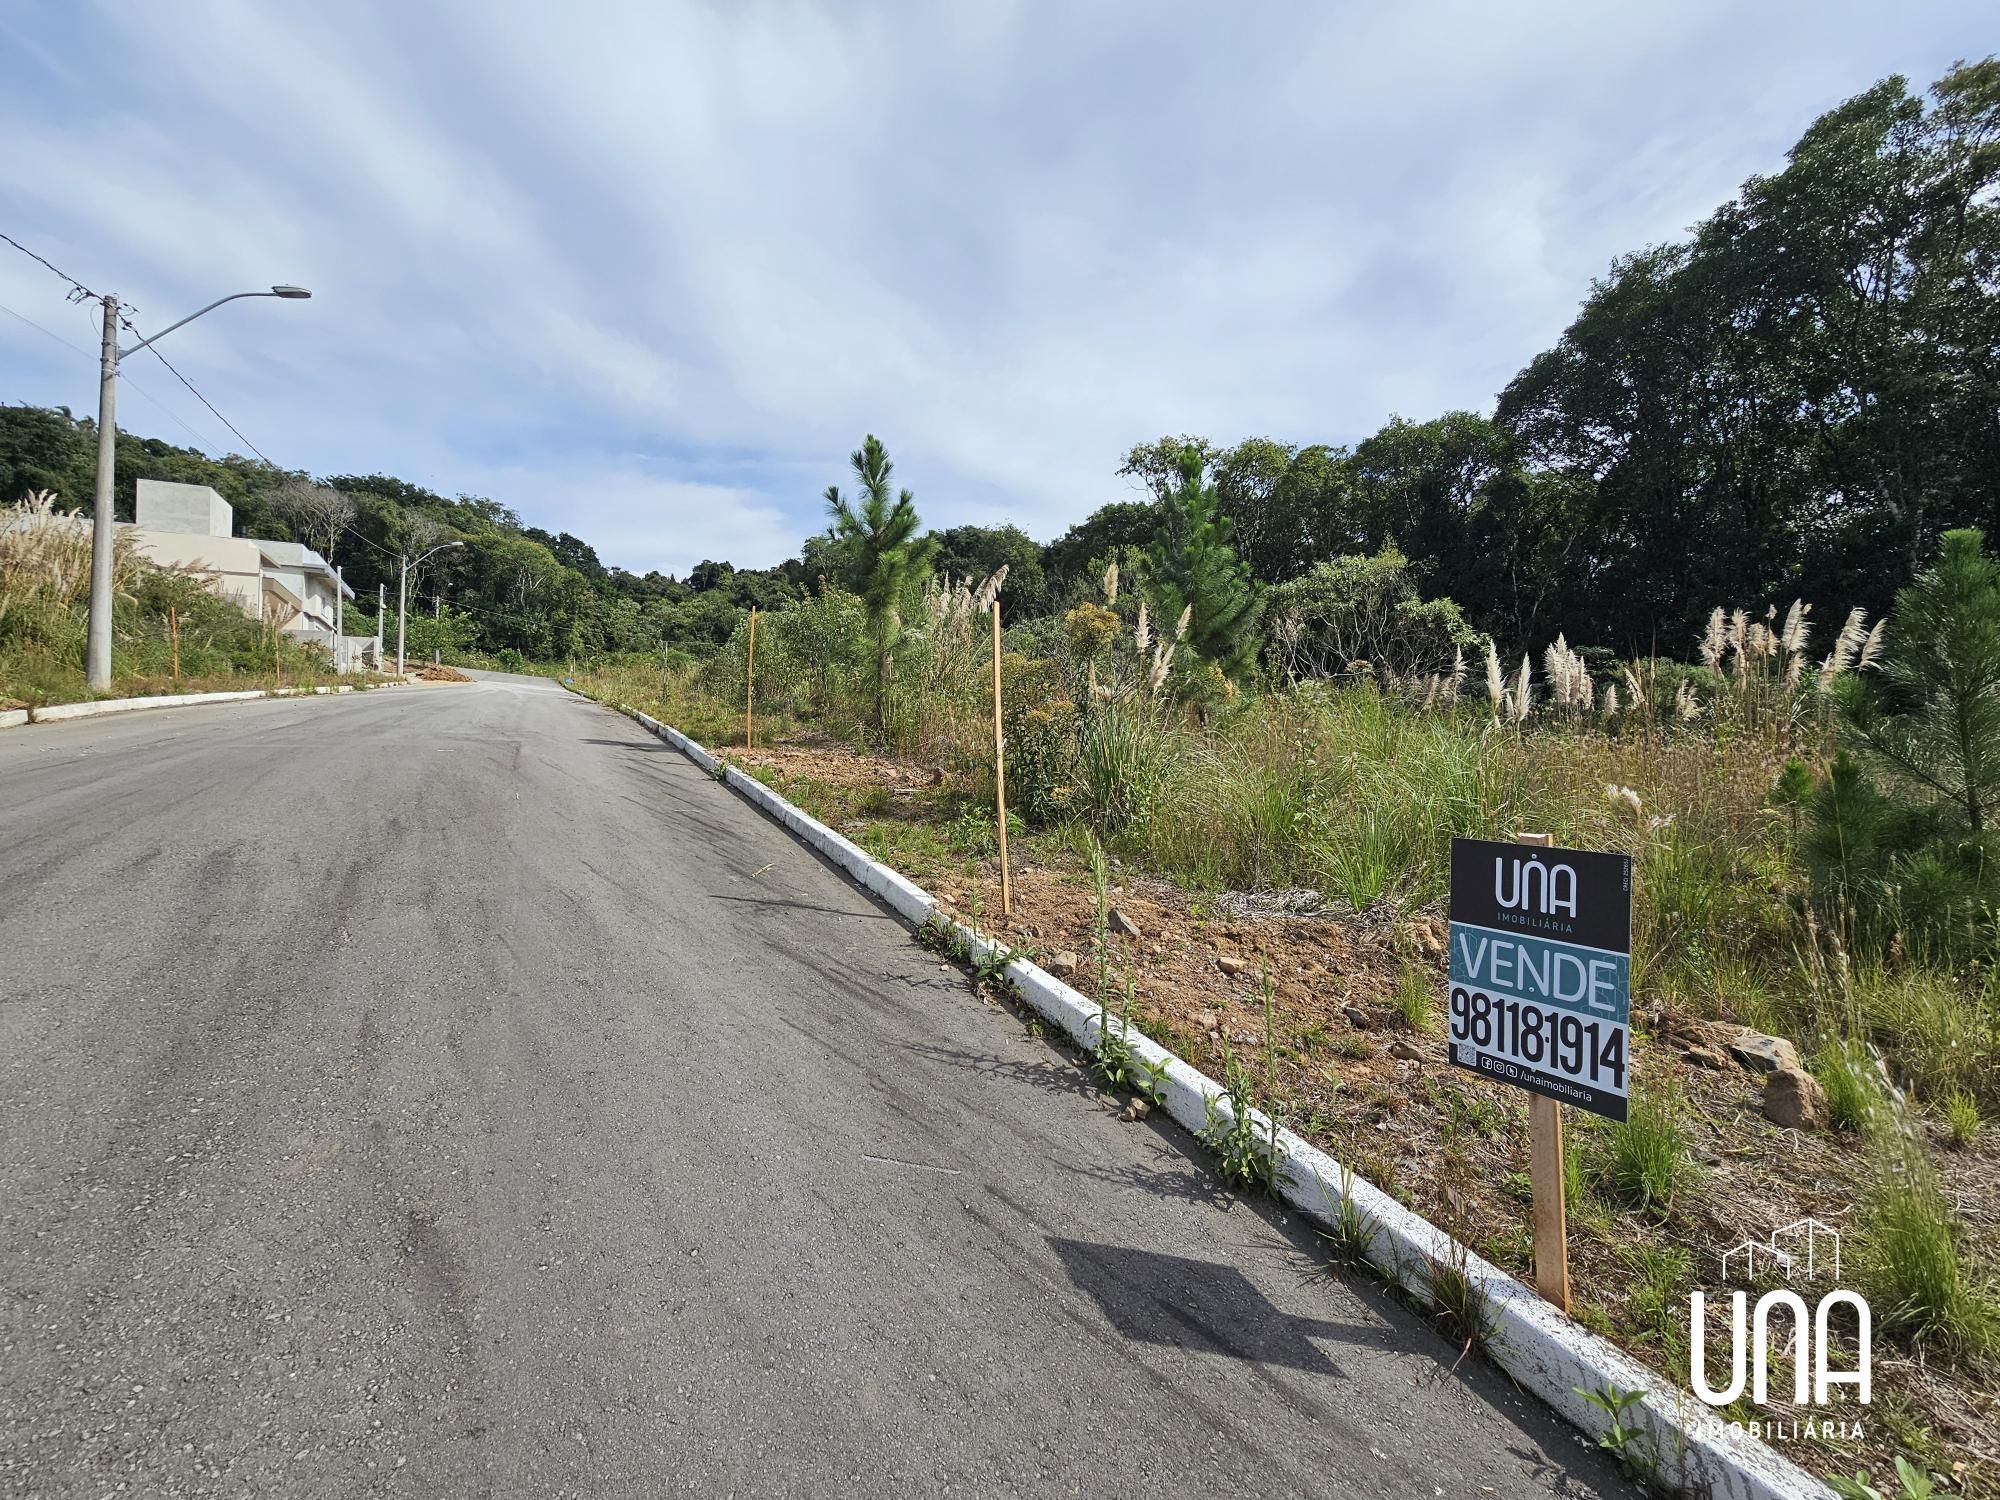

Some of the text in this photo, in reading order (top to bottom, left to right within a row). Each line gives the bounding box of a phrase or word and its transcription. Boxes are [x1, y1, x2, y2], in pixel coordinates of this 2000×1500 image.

[1495, 856, 1577, 918] UNA
[1497, 911, 1574, 934] IMOBILIÁRIA
[1458, 931, 1617, 1012] VENDE
[1520, 1069, 1593, 1103] /unaimobiliaria
